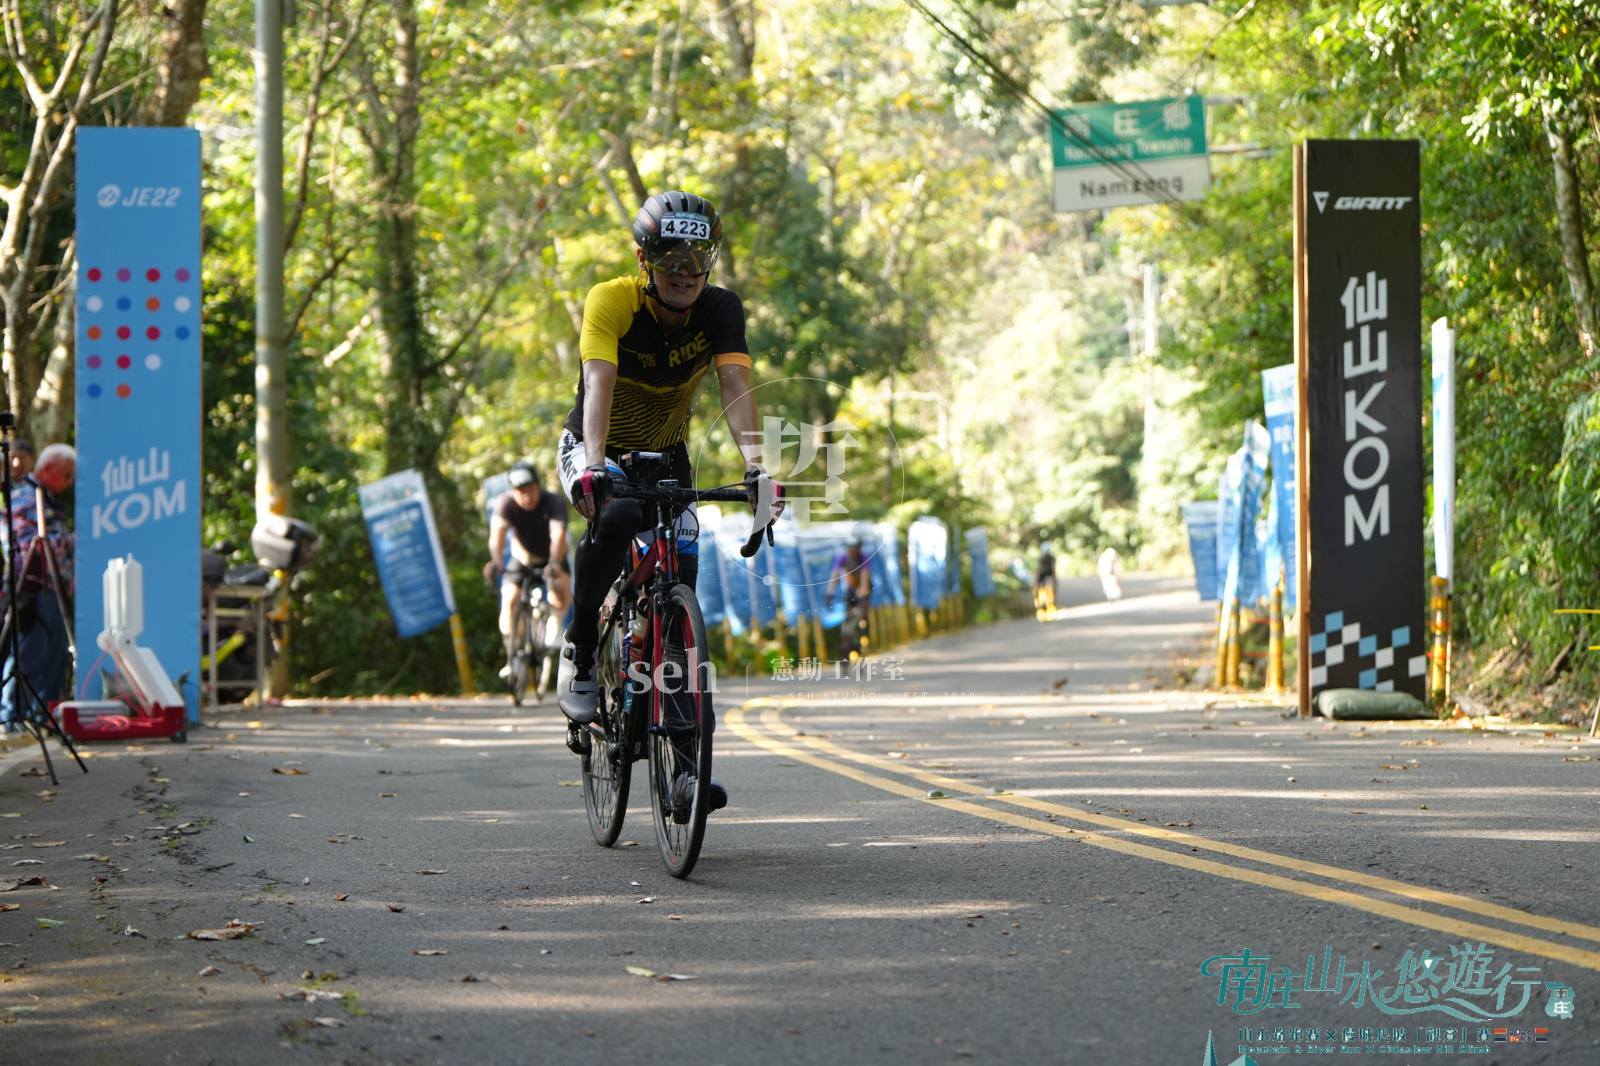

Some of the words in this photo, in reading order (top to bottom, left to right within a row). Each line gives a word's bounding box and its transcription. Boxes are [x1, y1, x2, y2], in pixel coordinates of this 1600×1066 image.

[122, 187, 181, 208] JE22
[1334, 196, 1412, 211] GIANT
[669, 330, 711, 368] RIDE
[101, 446, 170, 497] 仙山
[91, 480, 186, 539] KOM
